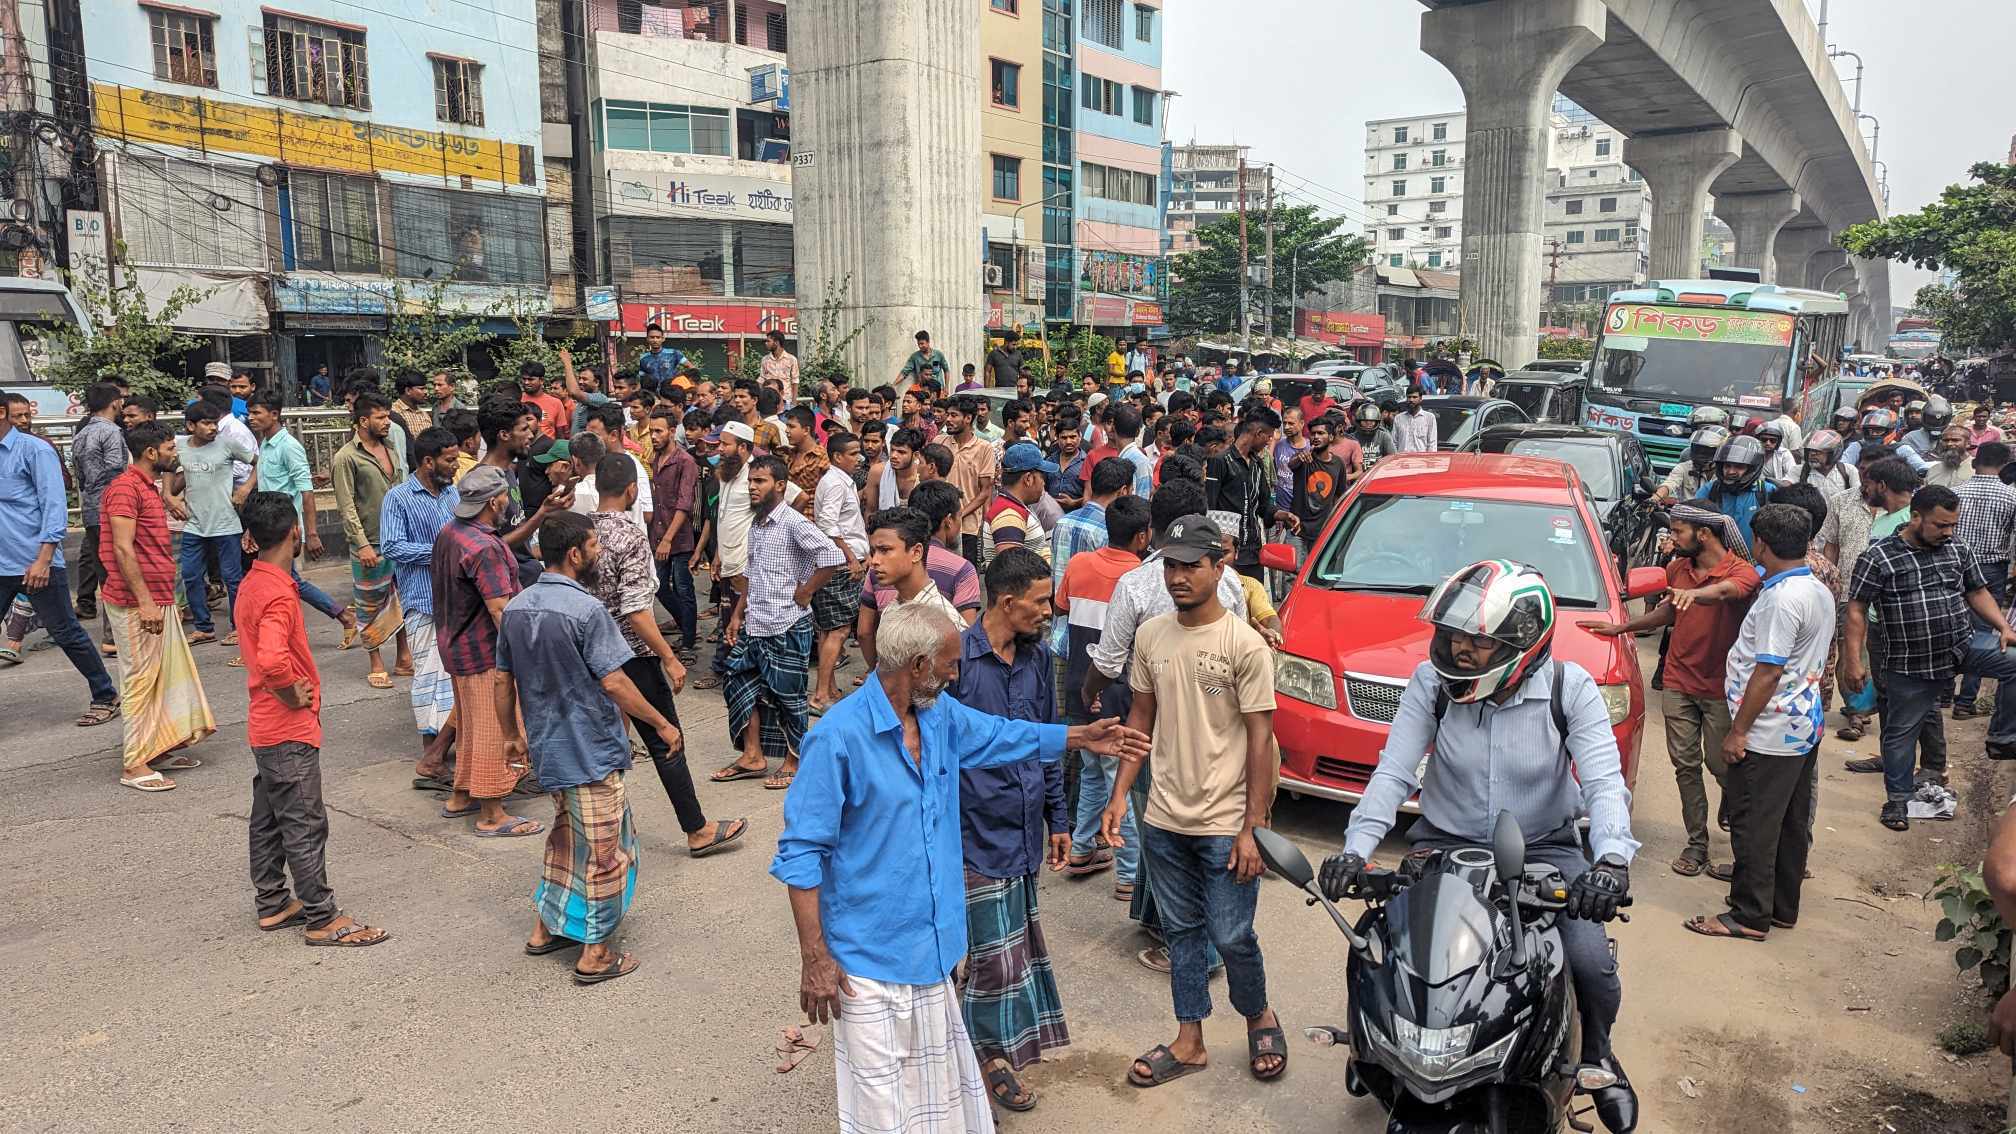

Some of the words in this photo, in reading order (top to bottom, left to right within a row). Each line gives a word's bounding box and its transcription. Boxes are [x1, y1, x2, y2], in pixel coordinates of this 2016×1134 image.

[667, 181, 690, 203] Hi
[693, 189, 736, 206] Teak
[673, 314, 727, 331] Teak
[1632, 307, 1723, 337] শিকড়
